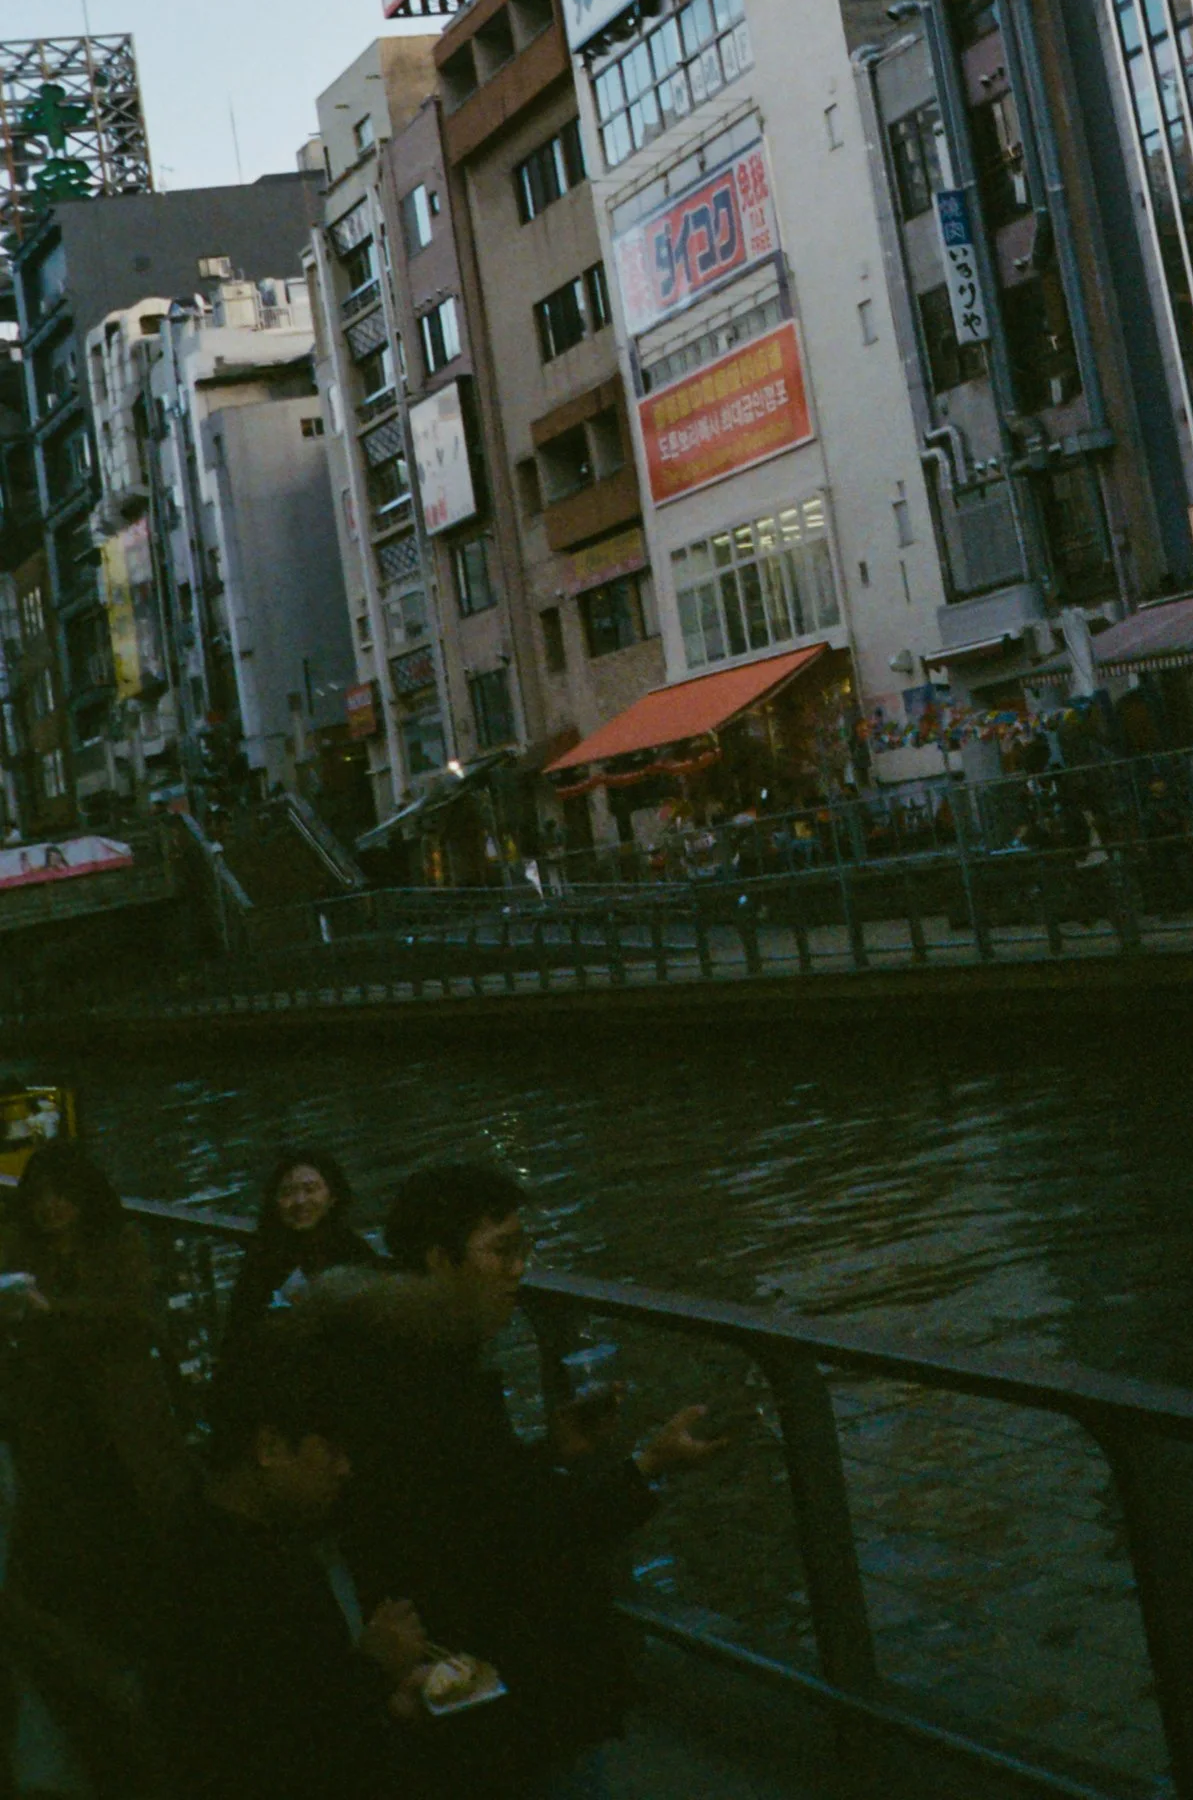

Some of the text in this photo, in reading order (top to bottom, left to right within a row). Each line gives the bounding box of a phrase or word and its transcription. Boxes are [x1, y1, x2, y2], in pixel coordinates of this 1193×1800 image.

[654, 187, 738, 299] ダイコク
[949, 247, 982, 337] いろりや
